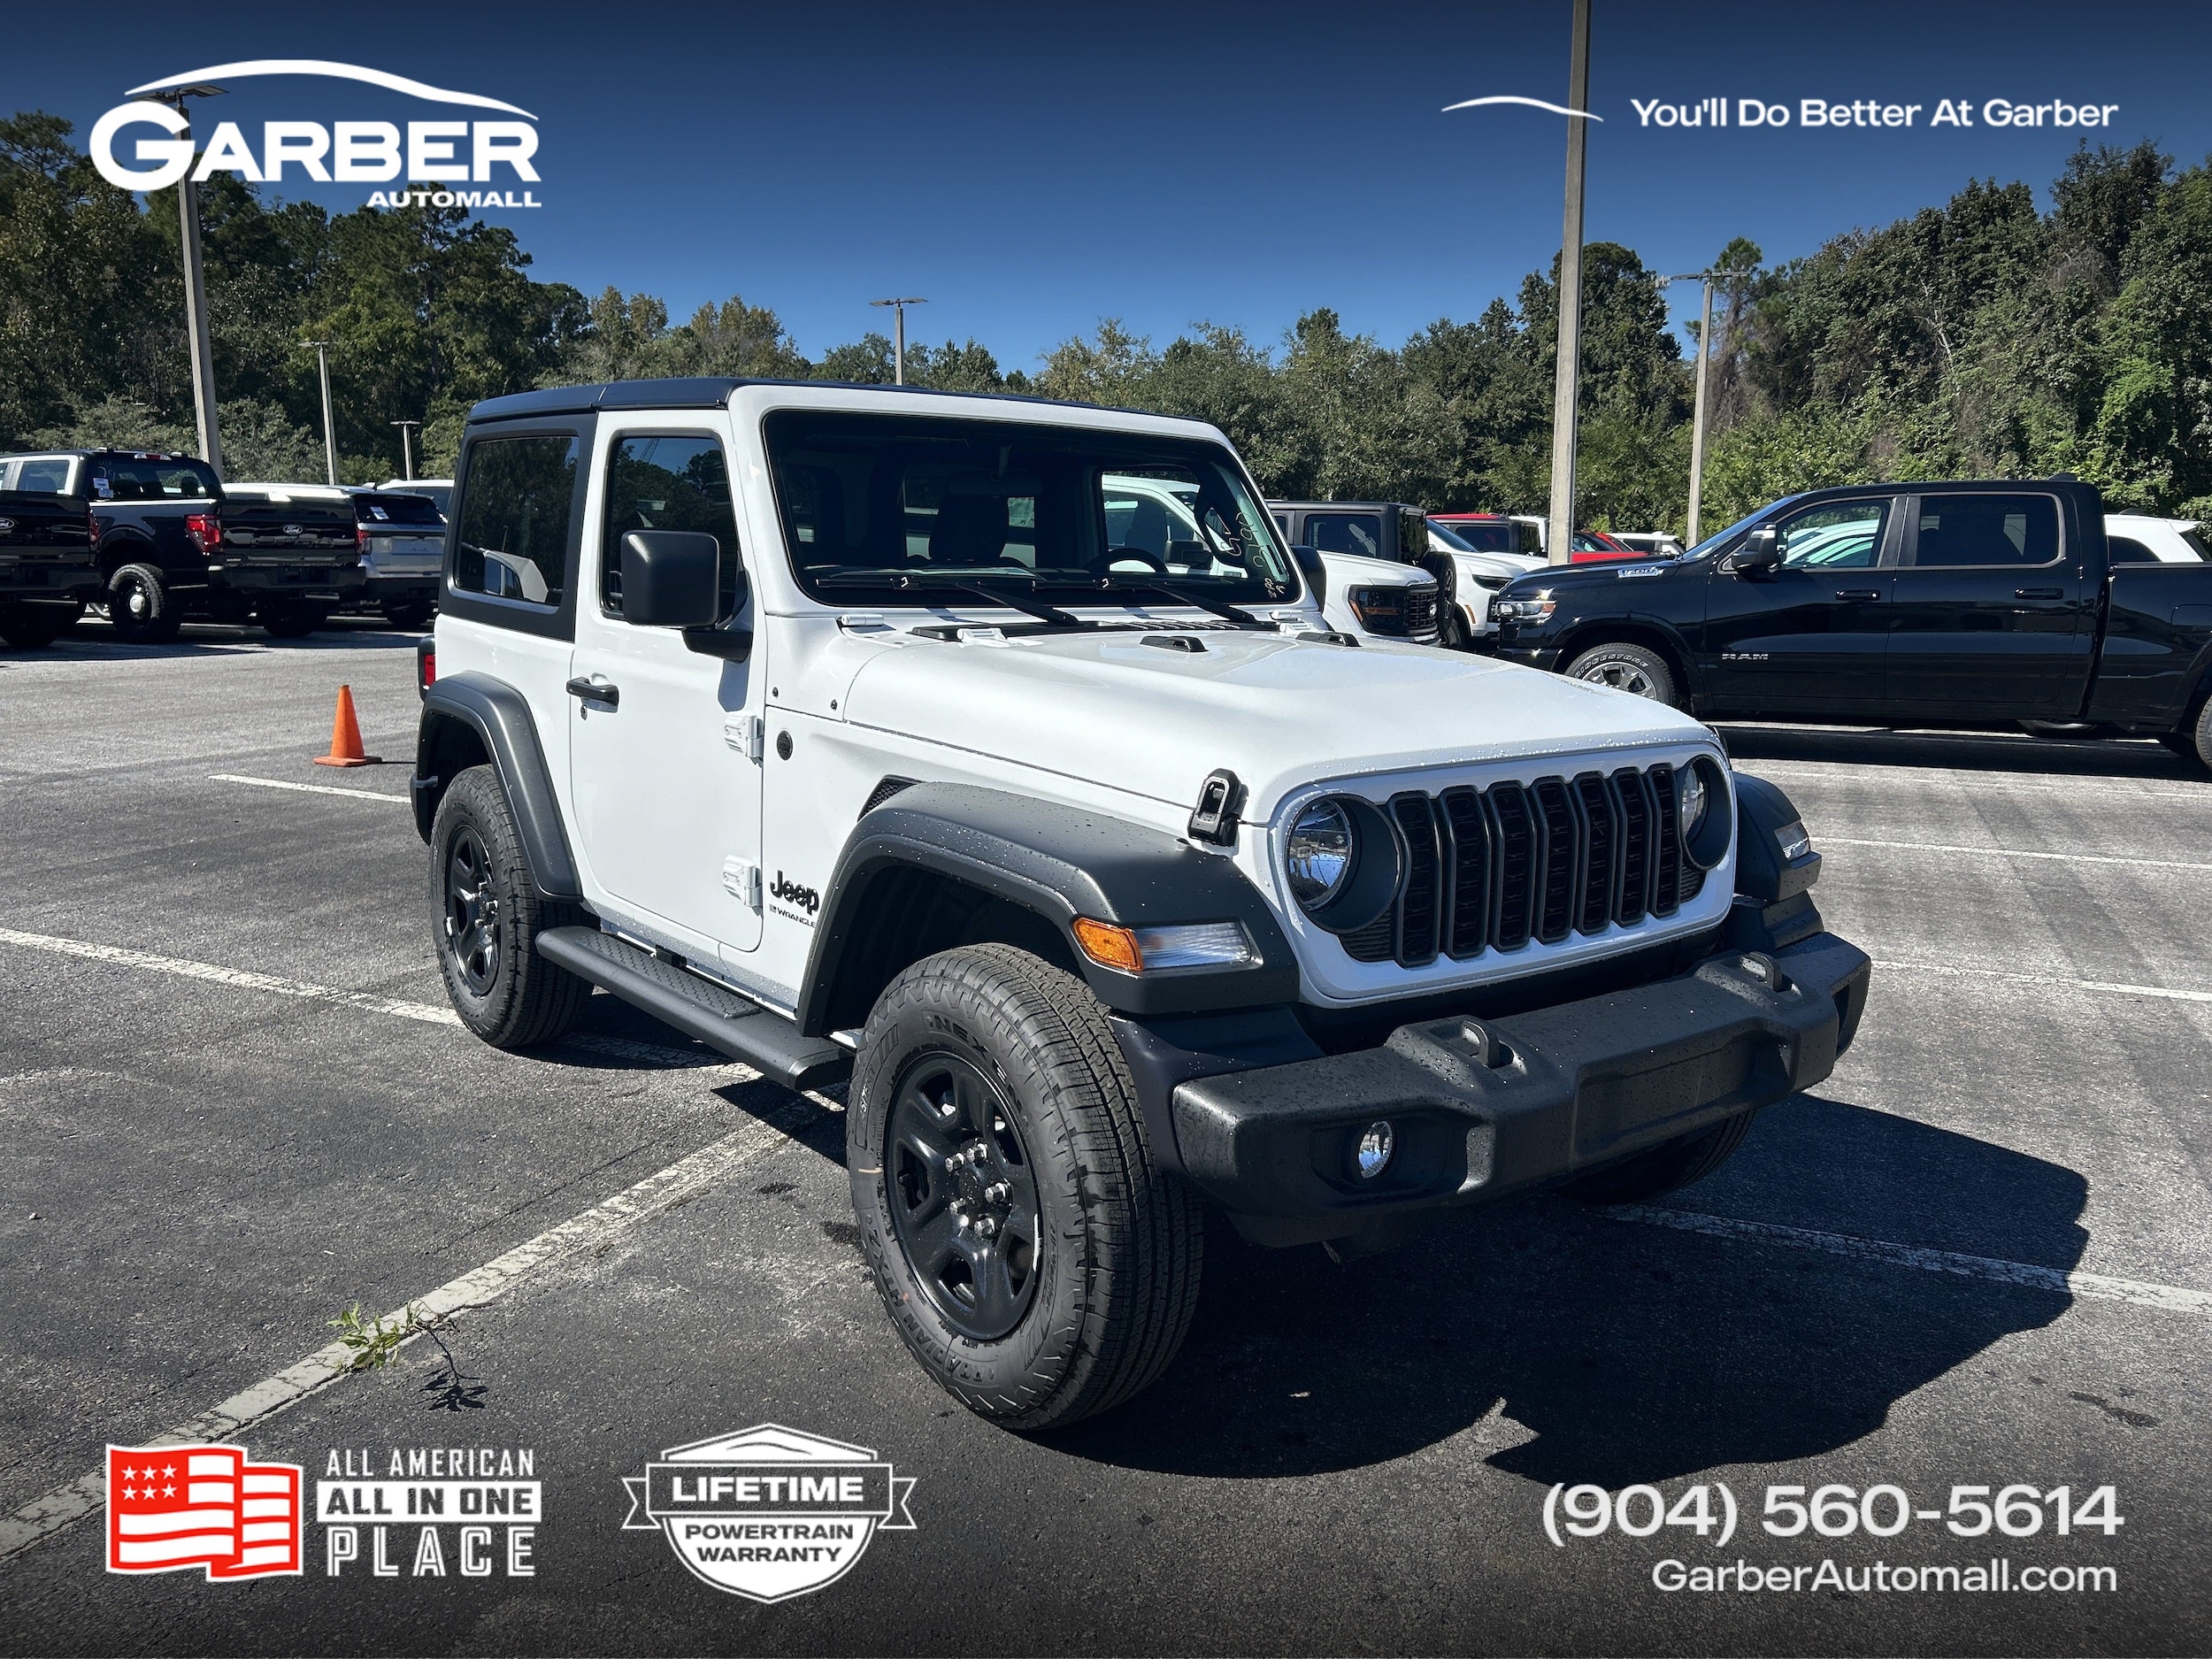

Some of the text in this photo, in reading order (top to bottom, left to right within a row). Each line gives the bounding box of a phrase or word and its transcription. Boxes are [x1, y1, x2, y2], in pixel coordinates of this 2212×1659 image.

[1575, 654, 1648, 678] RIDGESTONE
[769, 869, 820, 916] Jeep
[777, 907, 817, 928] WRANGLE
